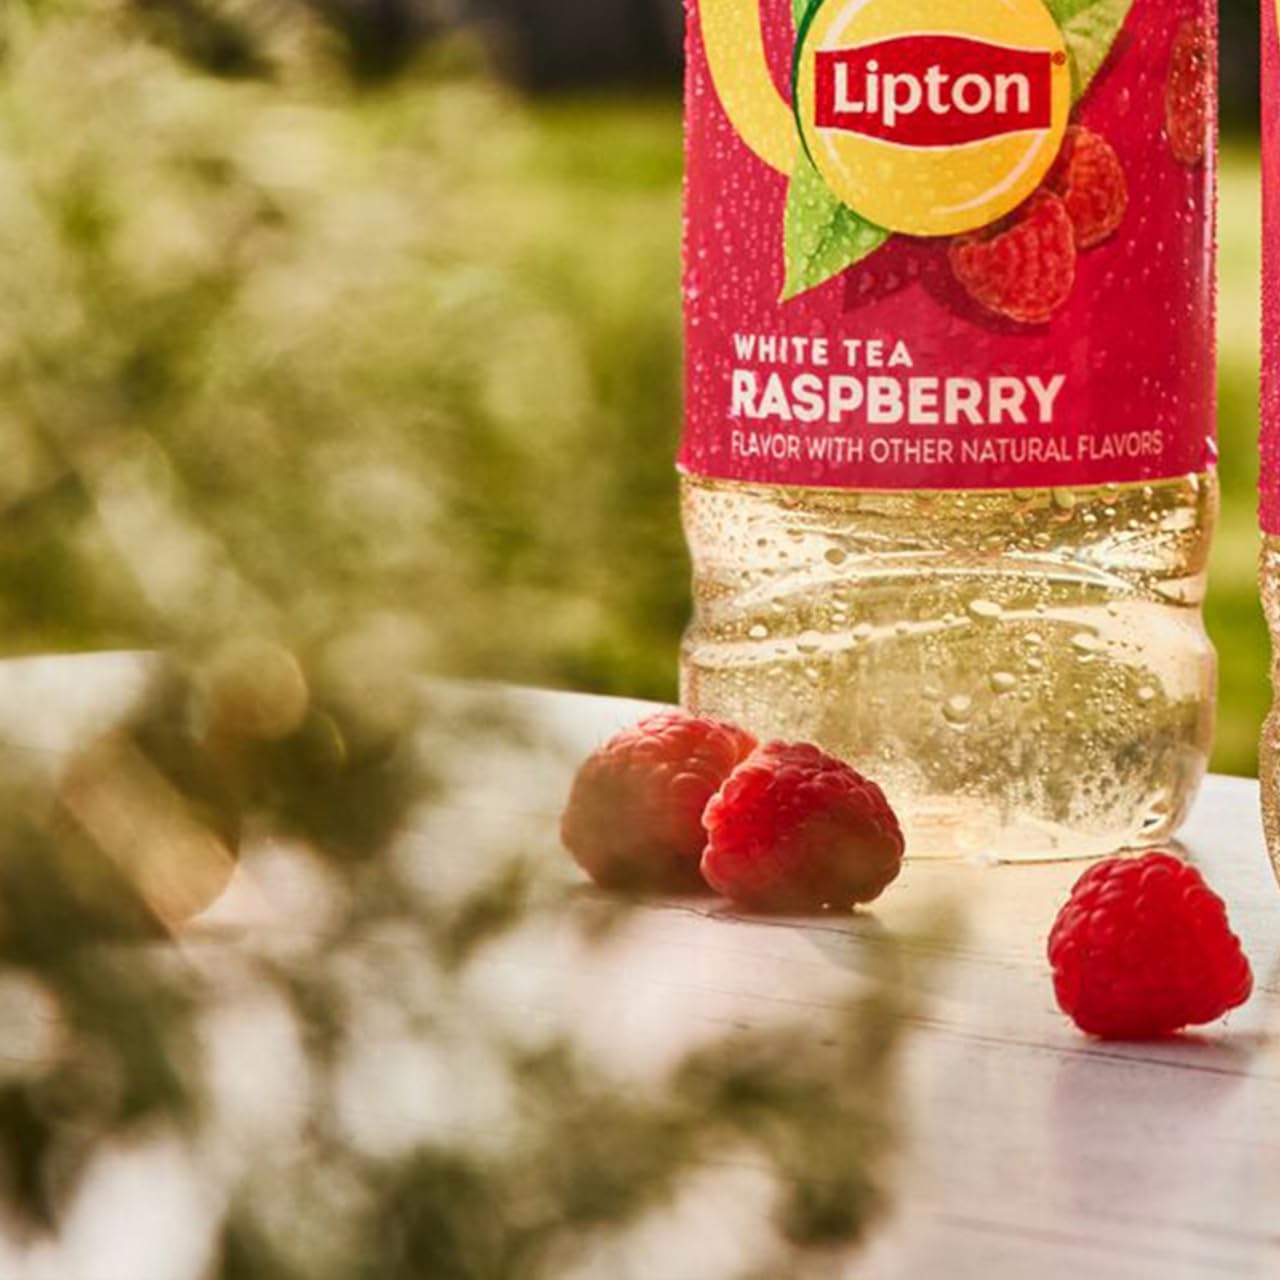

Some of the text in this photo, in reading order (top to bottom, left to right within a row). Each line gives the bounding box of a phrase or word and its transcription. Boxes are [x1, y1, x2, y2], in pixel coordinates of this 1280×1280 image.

[833, 59, 1030, 127] Lipton
[732, 333, 913, 368] WHITE TEA
[730, 368, 1065, 426] RASPBERRY
[731, 429, 1163, 464] FLAVOR WITH OTHER NATURAL FLAVORS
